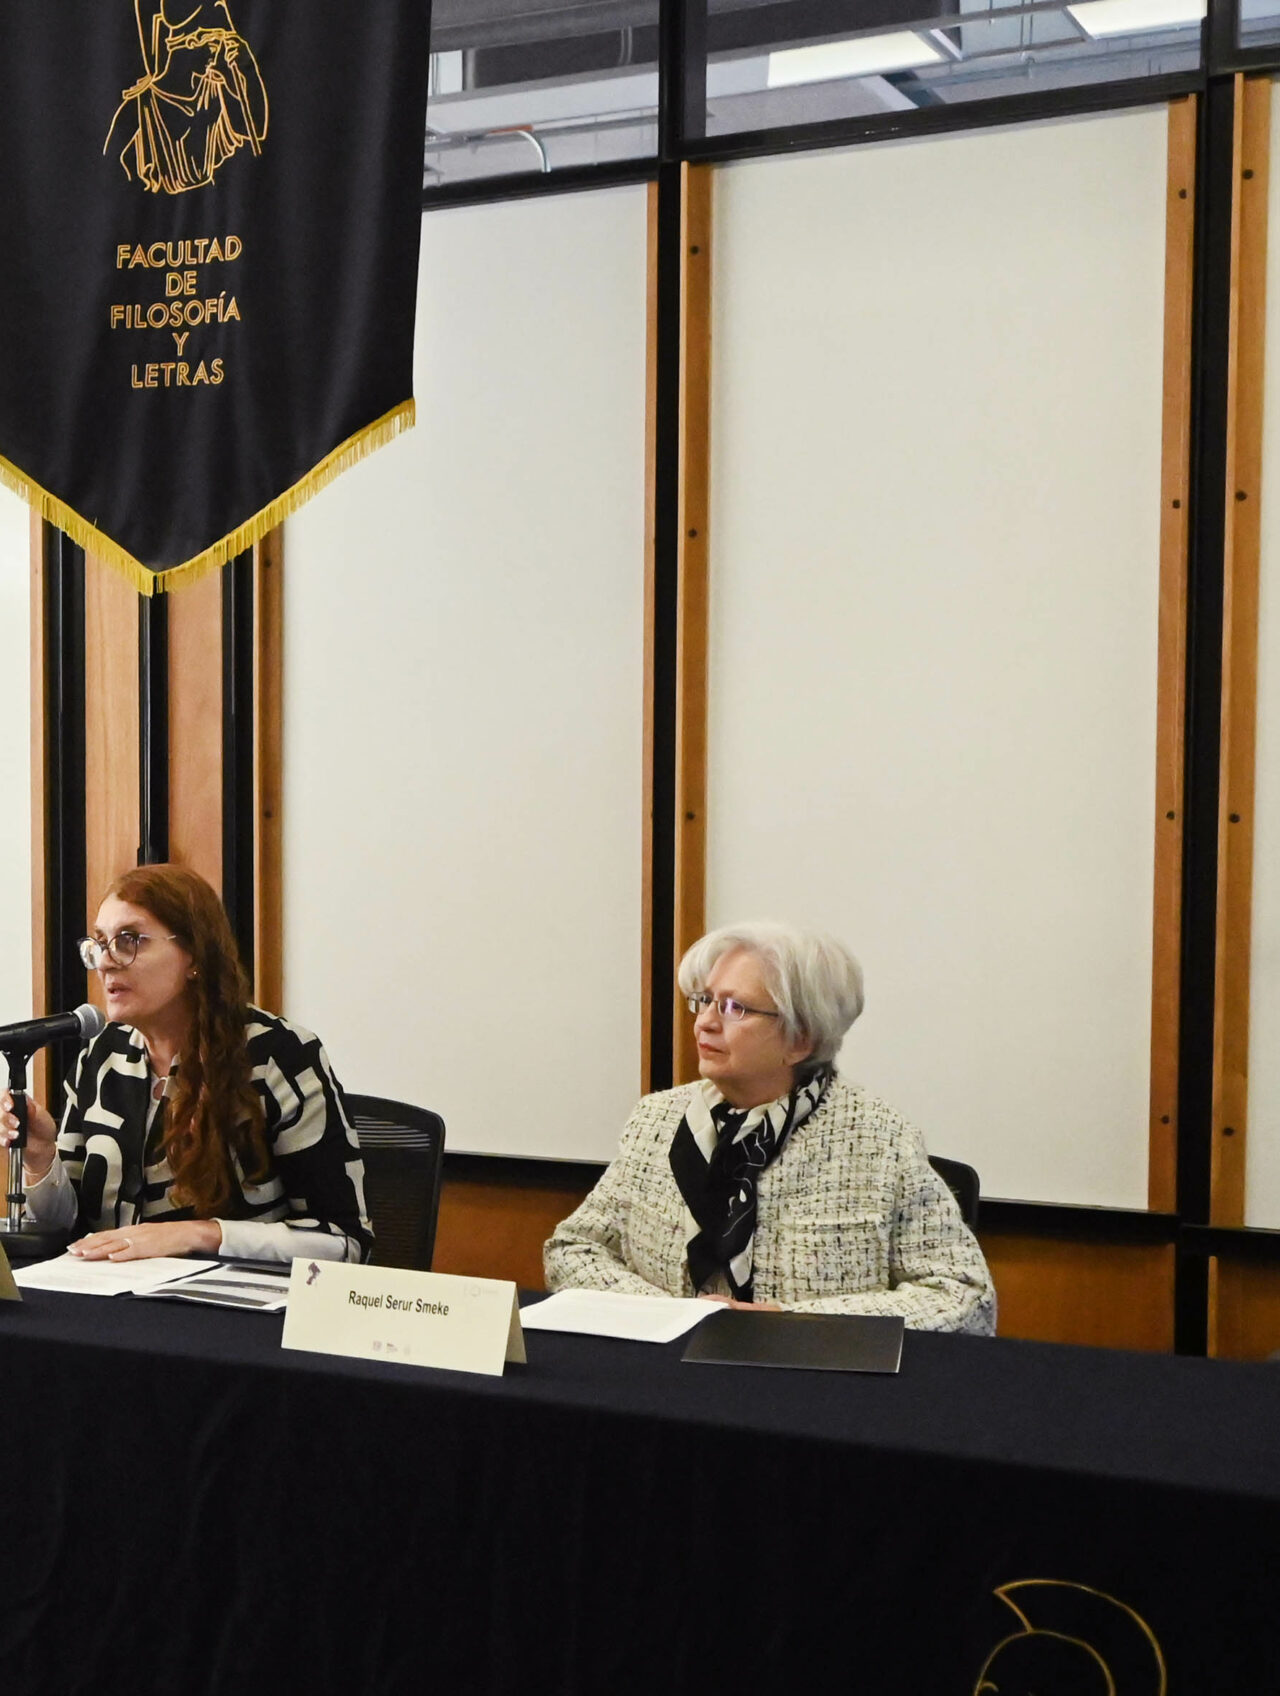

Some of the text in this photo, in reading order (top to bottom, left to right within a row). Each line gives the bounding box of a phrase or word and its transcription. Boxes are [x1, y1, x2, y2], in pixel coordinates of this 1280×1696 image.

[116, 235, 243, 269] FACULTAD
[165, 270, 197, 297] DE
[110, 290, 241, 329] FILOSOFÍA
[172, 331, 190, 357] Y
[131, 358, 225, 388] LETRAS
[348, 1290, 450, 1316] Raquel Serur Smeke
